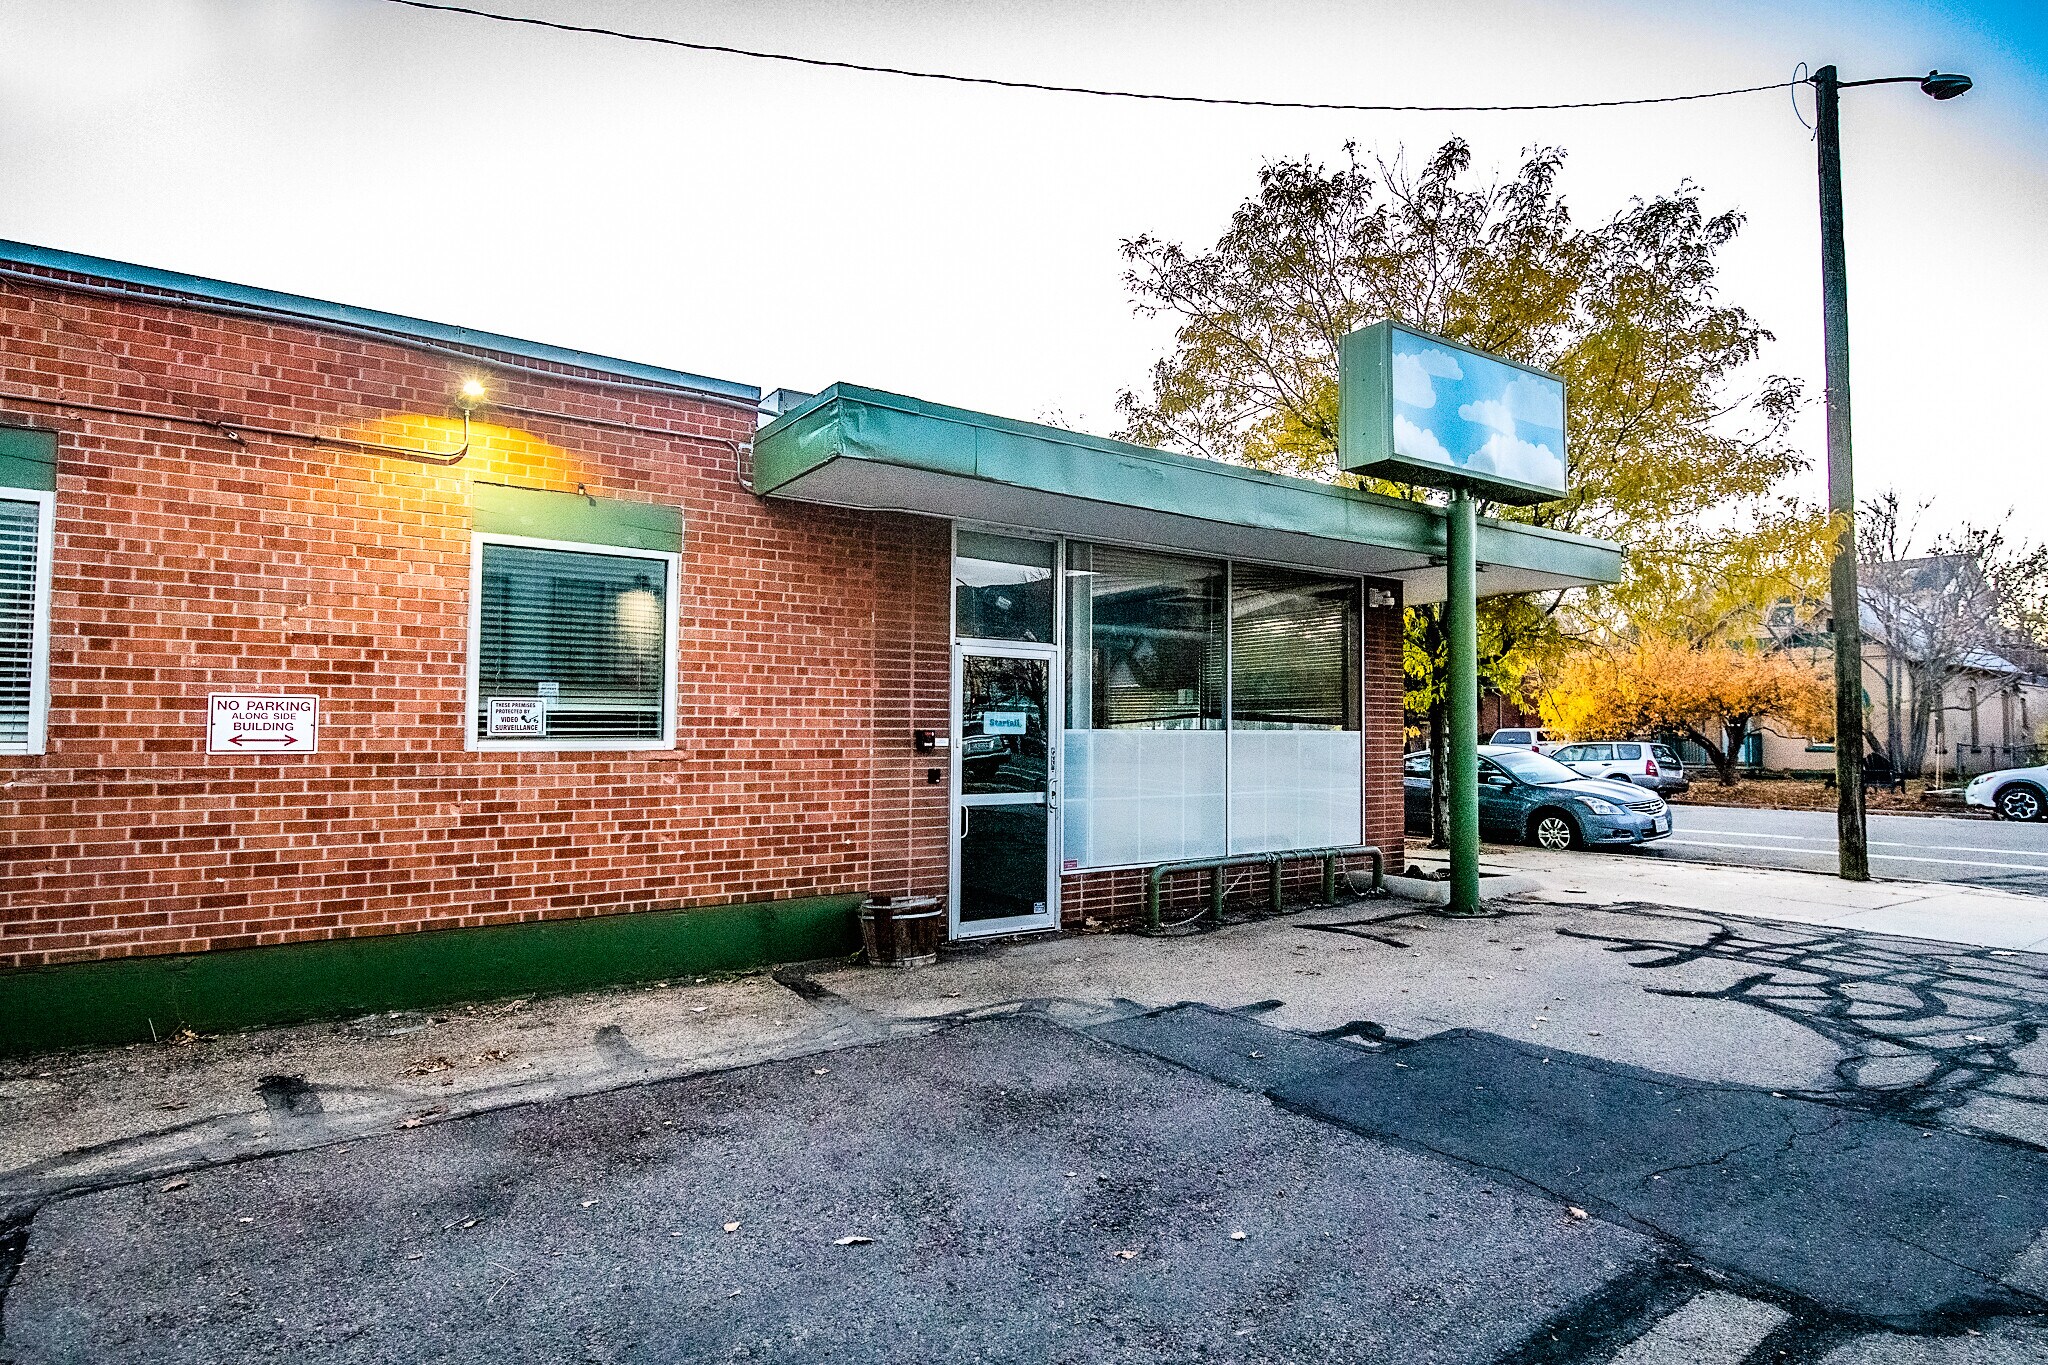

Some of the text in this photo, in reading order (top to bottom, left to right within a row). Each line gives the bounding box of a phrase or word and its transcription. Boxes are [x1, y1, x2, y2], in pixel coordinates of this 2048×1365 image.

[217, 700, 311, 712] NO PARKING
[232, 712, 268, 720] ALONG
[233, 722, 294, 731] BUILDING
